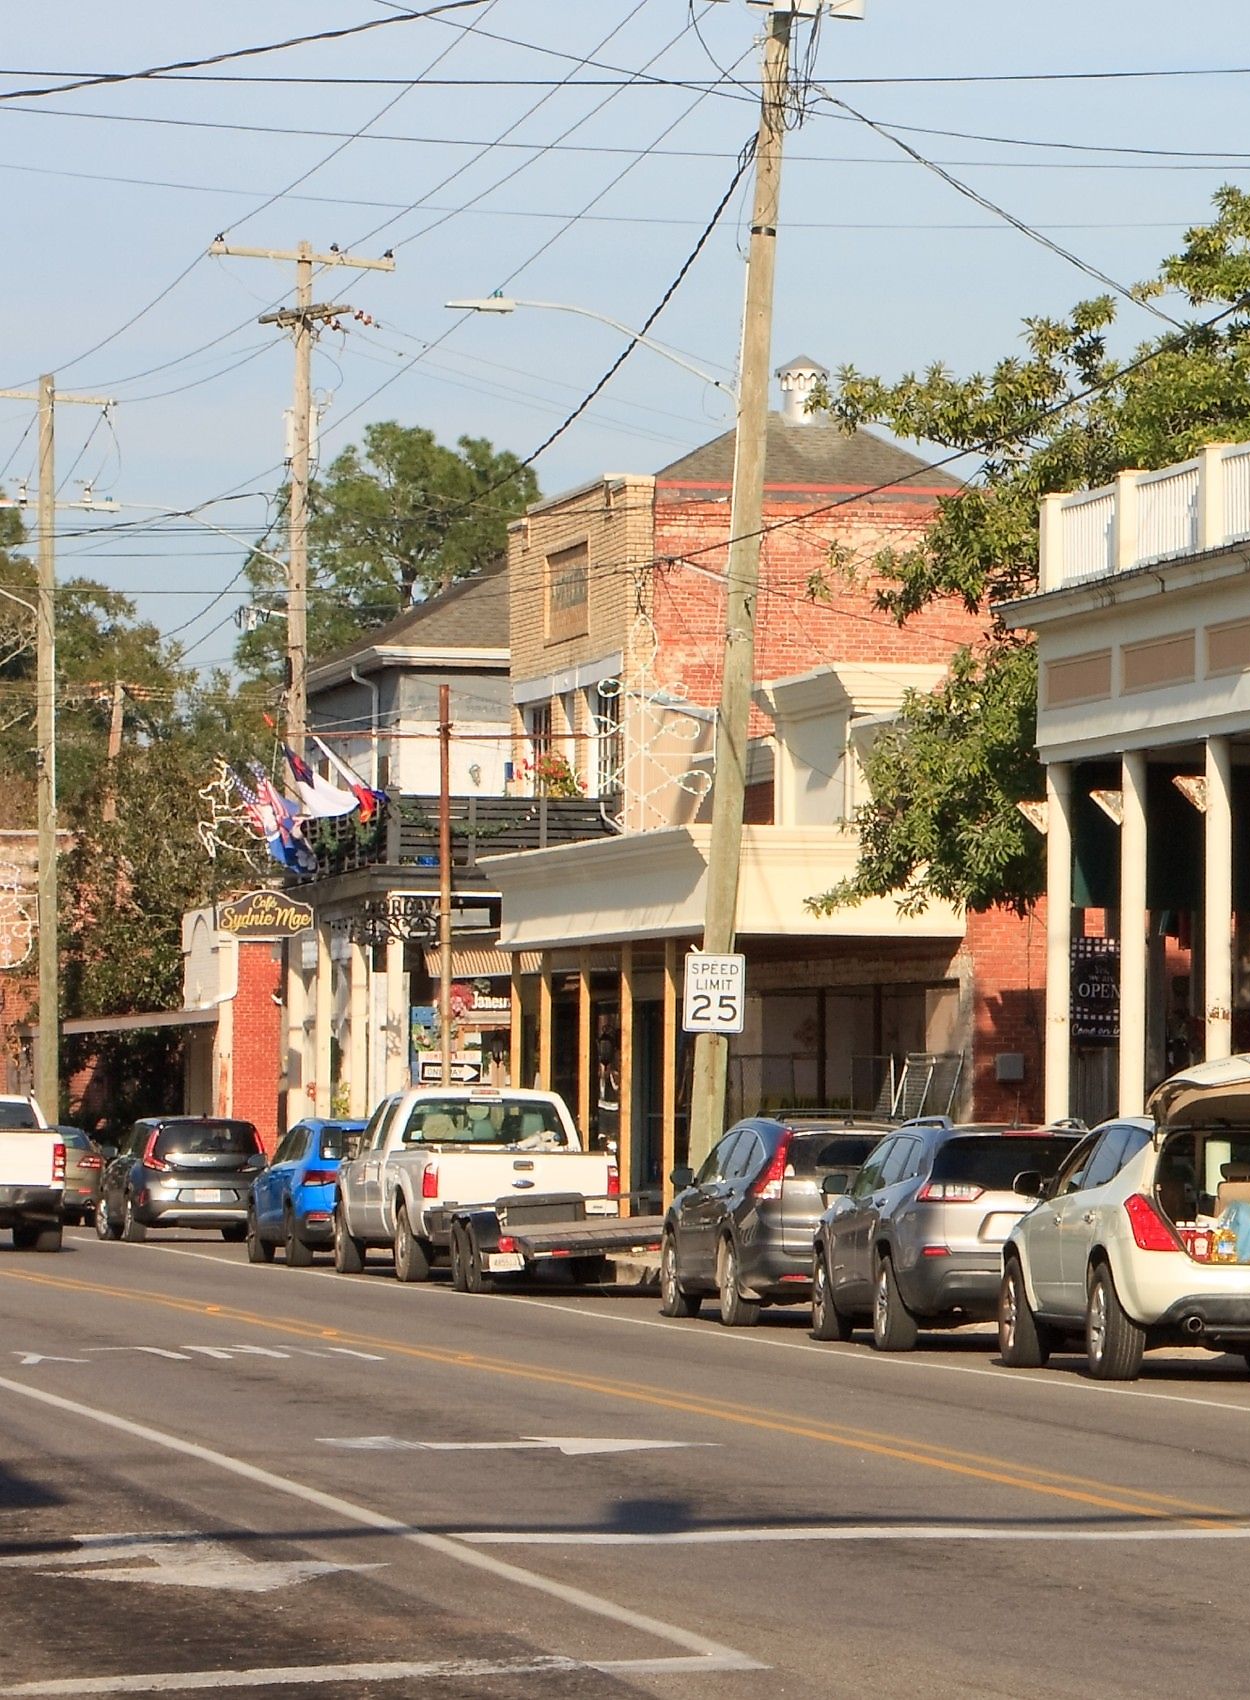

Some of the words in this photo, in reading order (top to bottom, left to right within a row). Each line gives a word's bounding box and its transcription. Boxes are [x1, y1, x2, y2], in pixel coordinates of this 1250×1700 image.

[220, 907, 275, 932] Sydnie
[275, 907, 312, 930] Mae
[691, 963, 739, 975] SPEED
[696, 979, 733, 991] LIMIT
[691, 994, 737, 1022] 25
